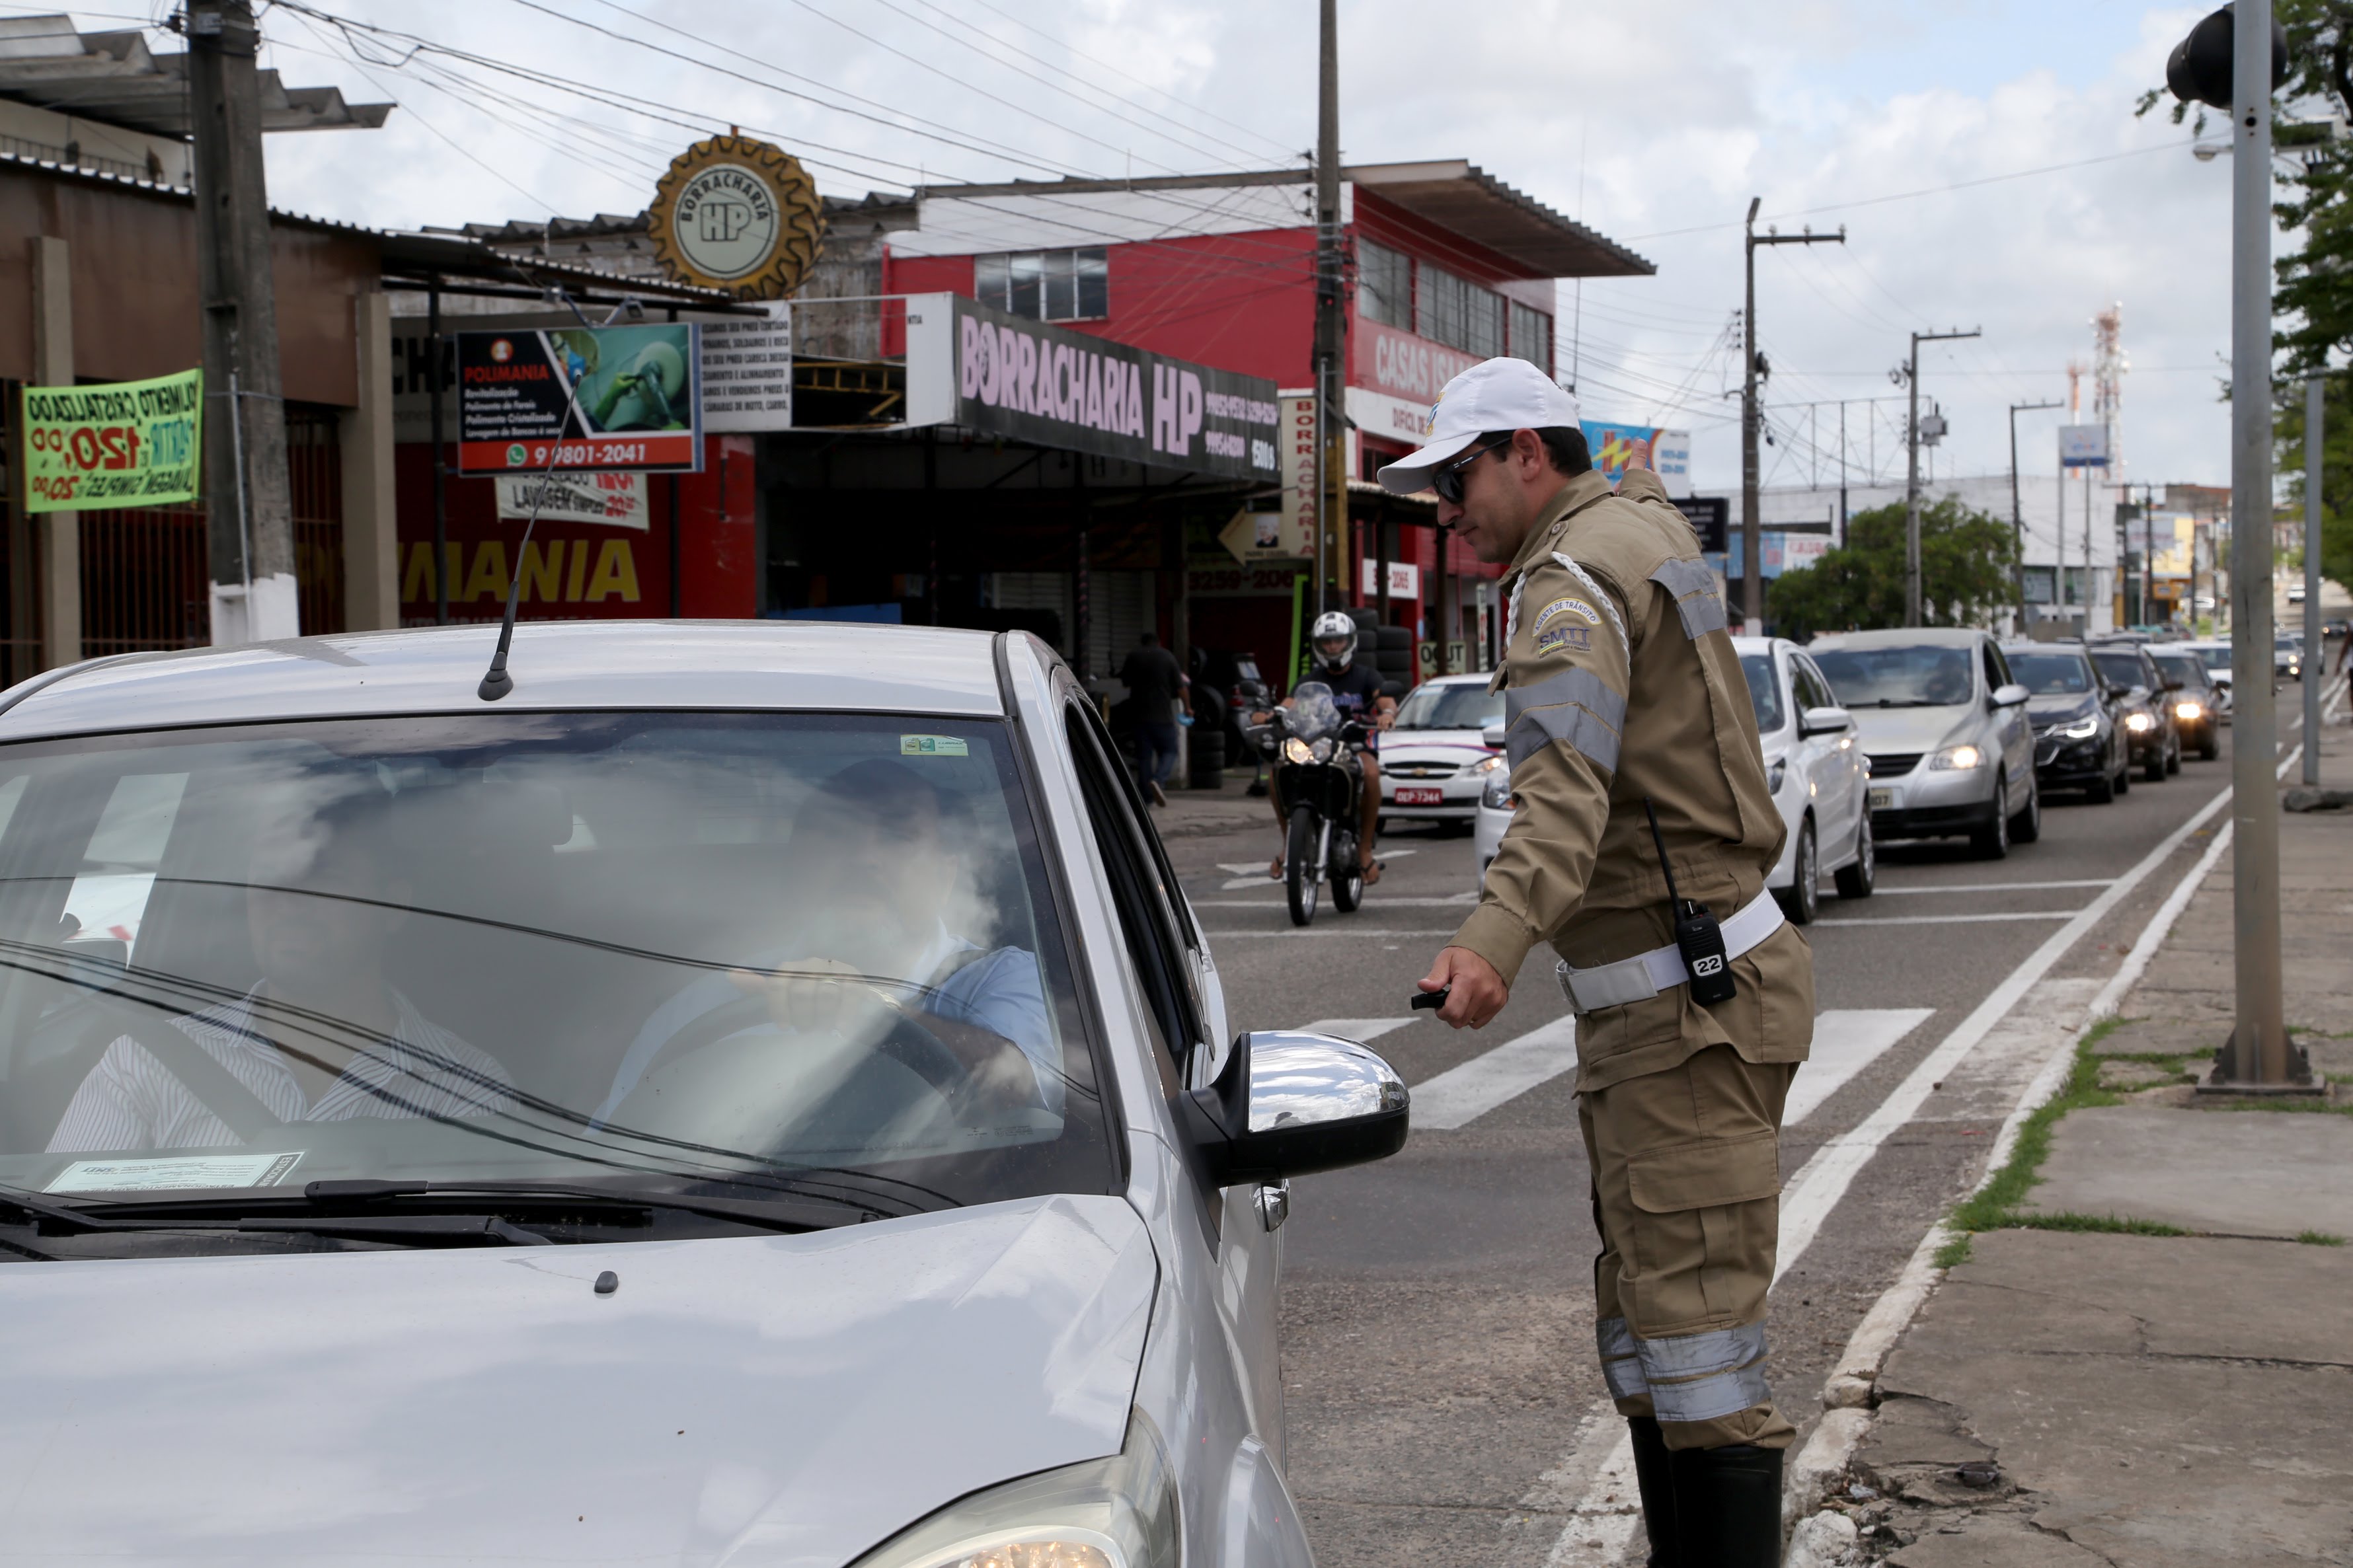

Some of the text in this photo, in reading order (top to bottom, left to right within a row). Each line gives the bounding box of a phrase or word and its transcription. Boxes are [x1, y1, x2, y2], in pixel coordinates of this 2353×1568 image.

[681, 174, 769, 222] BORRACHARIA
[701, 203, 751, 242] HP
[465, 364, 550, 383] POLIMANIA
[1375, 334, 1428, 396] CASAS
[961, 314, 1145, 439] BORRACHARIA
[464, 387, 520, 399] Revitalização
[465, 401, 502, 411] Polimento
[465, 411, 557, 424] Polimento Cristalizado
[465, 430, 499, 440] Lavagem
[535, 443, 646, 465] 9 9801-2041
[1295, 400, 1315, 556] BORRACHARIA
[512, 484, 574, 510] LAVAGEM
[1535, 606, 1555, 631] AGENTE
[1555, 601, 1563, 611] DE
[1539, 628, 1591, 648] SMTT
[1697, 957, 1720, 973] 22
